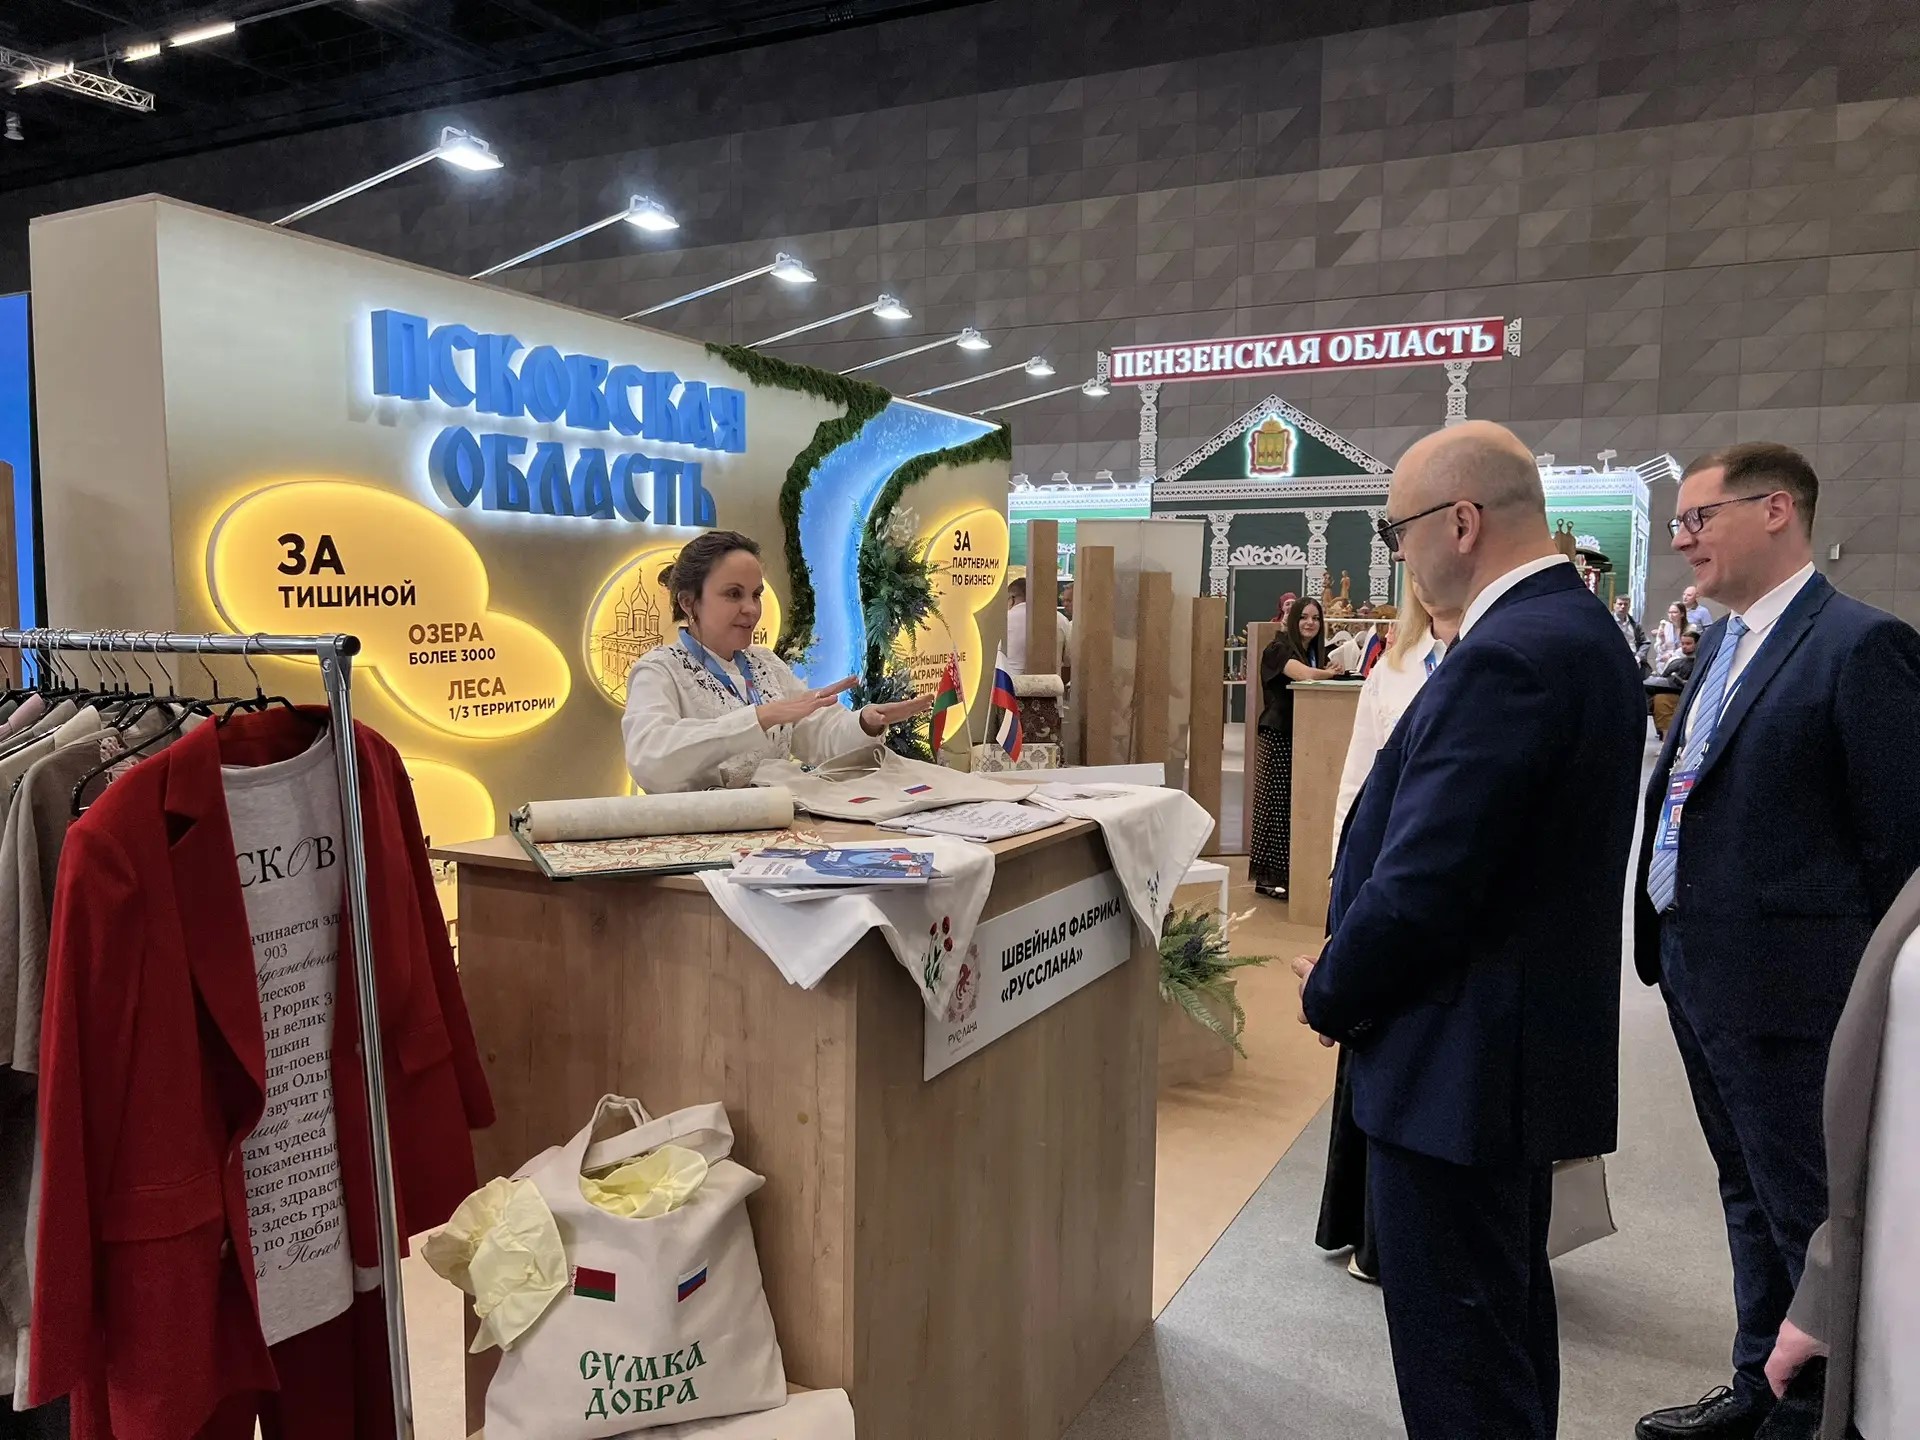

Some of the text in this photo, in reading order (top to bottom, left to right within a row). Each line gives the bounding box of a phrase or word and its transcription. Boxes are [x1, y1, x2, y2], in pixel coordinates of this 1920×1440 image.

[1113, 324, 1496, 379] ПЕНЗЕНСКАЯ ОБЛАСТЬ
[371, 309, 746, 453] ПСКОВСКАЯ
[428, 426, 717, 528] ОБЛАСТЬ
[953, 529, 971, 551] ЗА
[277, 533, 346, 576] ЗА
[952, 556, 1000, 569] ПАРТНЕРАМИ
[952, 574, 996, 586] ПО БИЗНЕСУ
[278, 580, 416, 608] ТИШИНОЙ
[408, 622, 484, 645] ОЗЕРА
[409, 648, 496, 665] БОЛЕЕ 3000
[448, 677, 507, 701] ЛЕСА
[449, 697, 556, 721] 1/3 ТЕРРИТОРИИ
[236, 835, 336, 888] СКОВ
[1001, 897, 1121, 972] ШВЕЙНАЯ ФАБРИКА
[264, 943, 288, 962] 903
[1001, 947, 1084, 1003] «РУССЛАНА»
[259, 980, 306, 1004] лесков
[272, 995, 320, 1020] Рюрик
[283, 1012, 327, 1035] велик
[292, 1067, 333, 1089] Ольг
[275, 1127, 327, 1152] чудеса
[245, 1179, 284, 1199] ские
[261, 1210, 308, 1233] здесь
[263, 1236, 285, 1253] по
[288, 1215, 340, 1244] любви
[277, 1233, 343, 1271] Псков
[579, 1340, 707, 1390] СУМКА
[585, 1377, 699, 1421] ДОБРА
